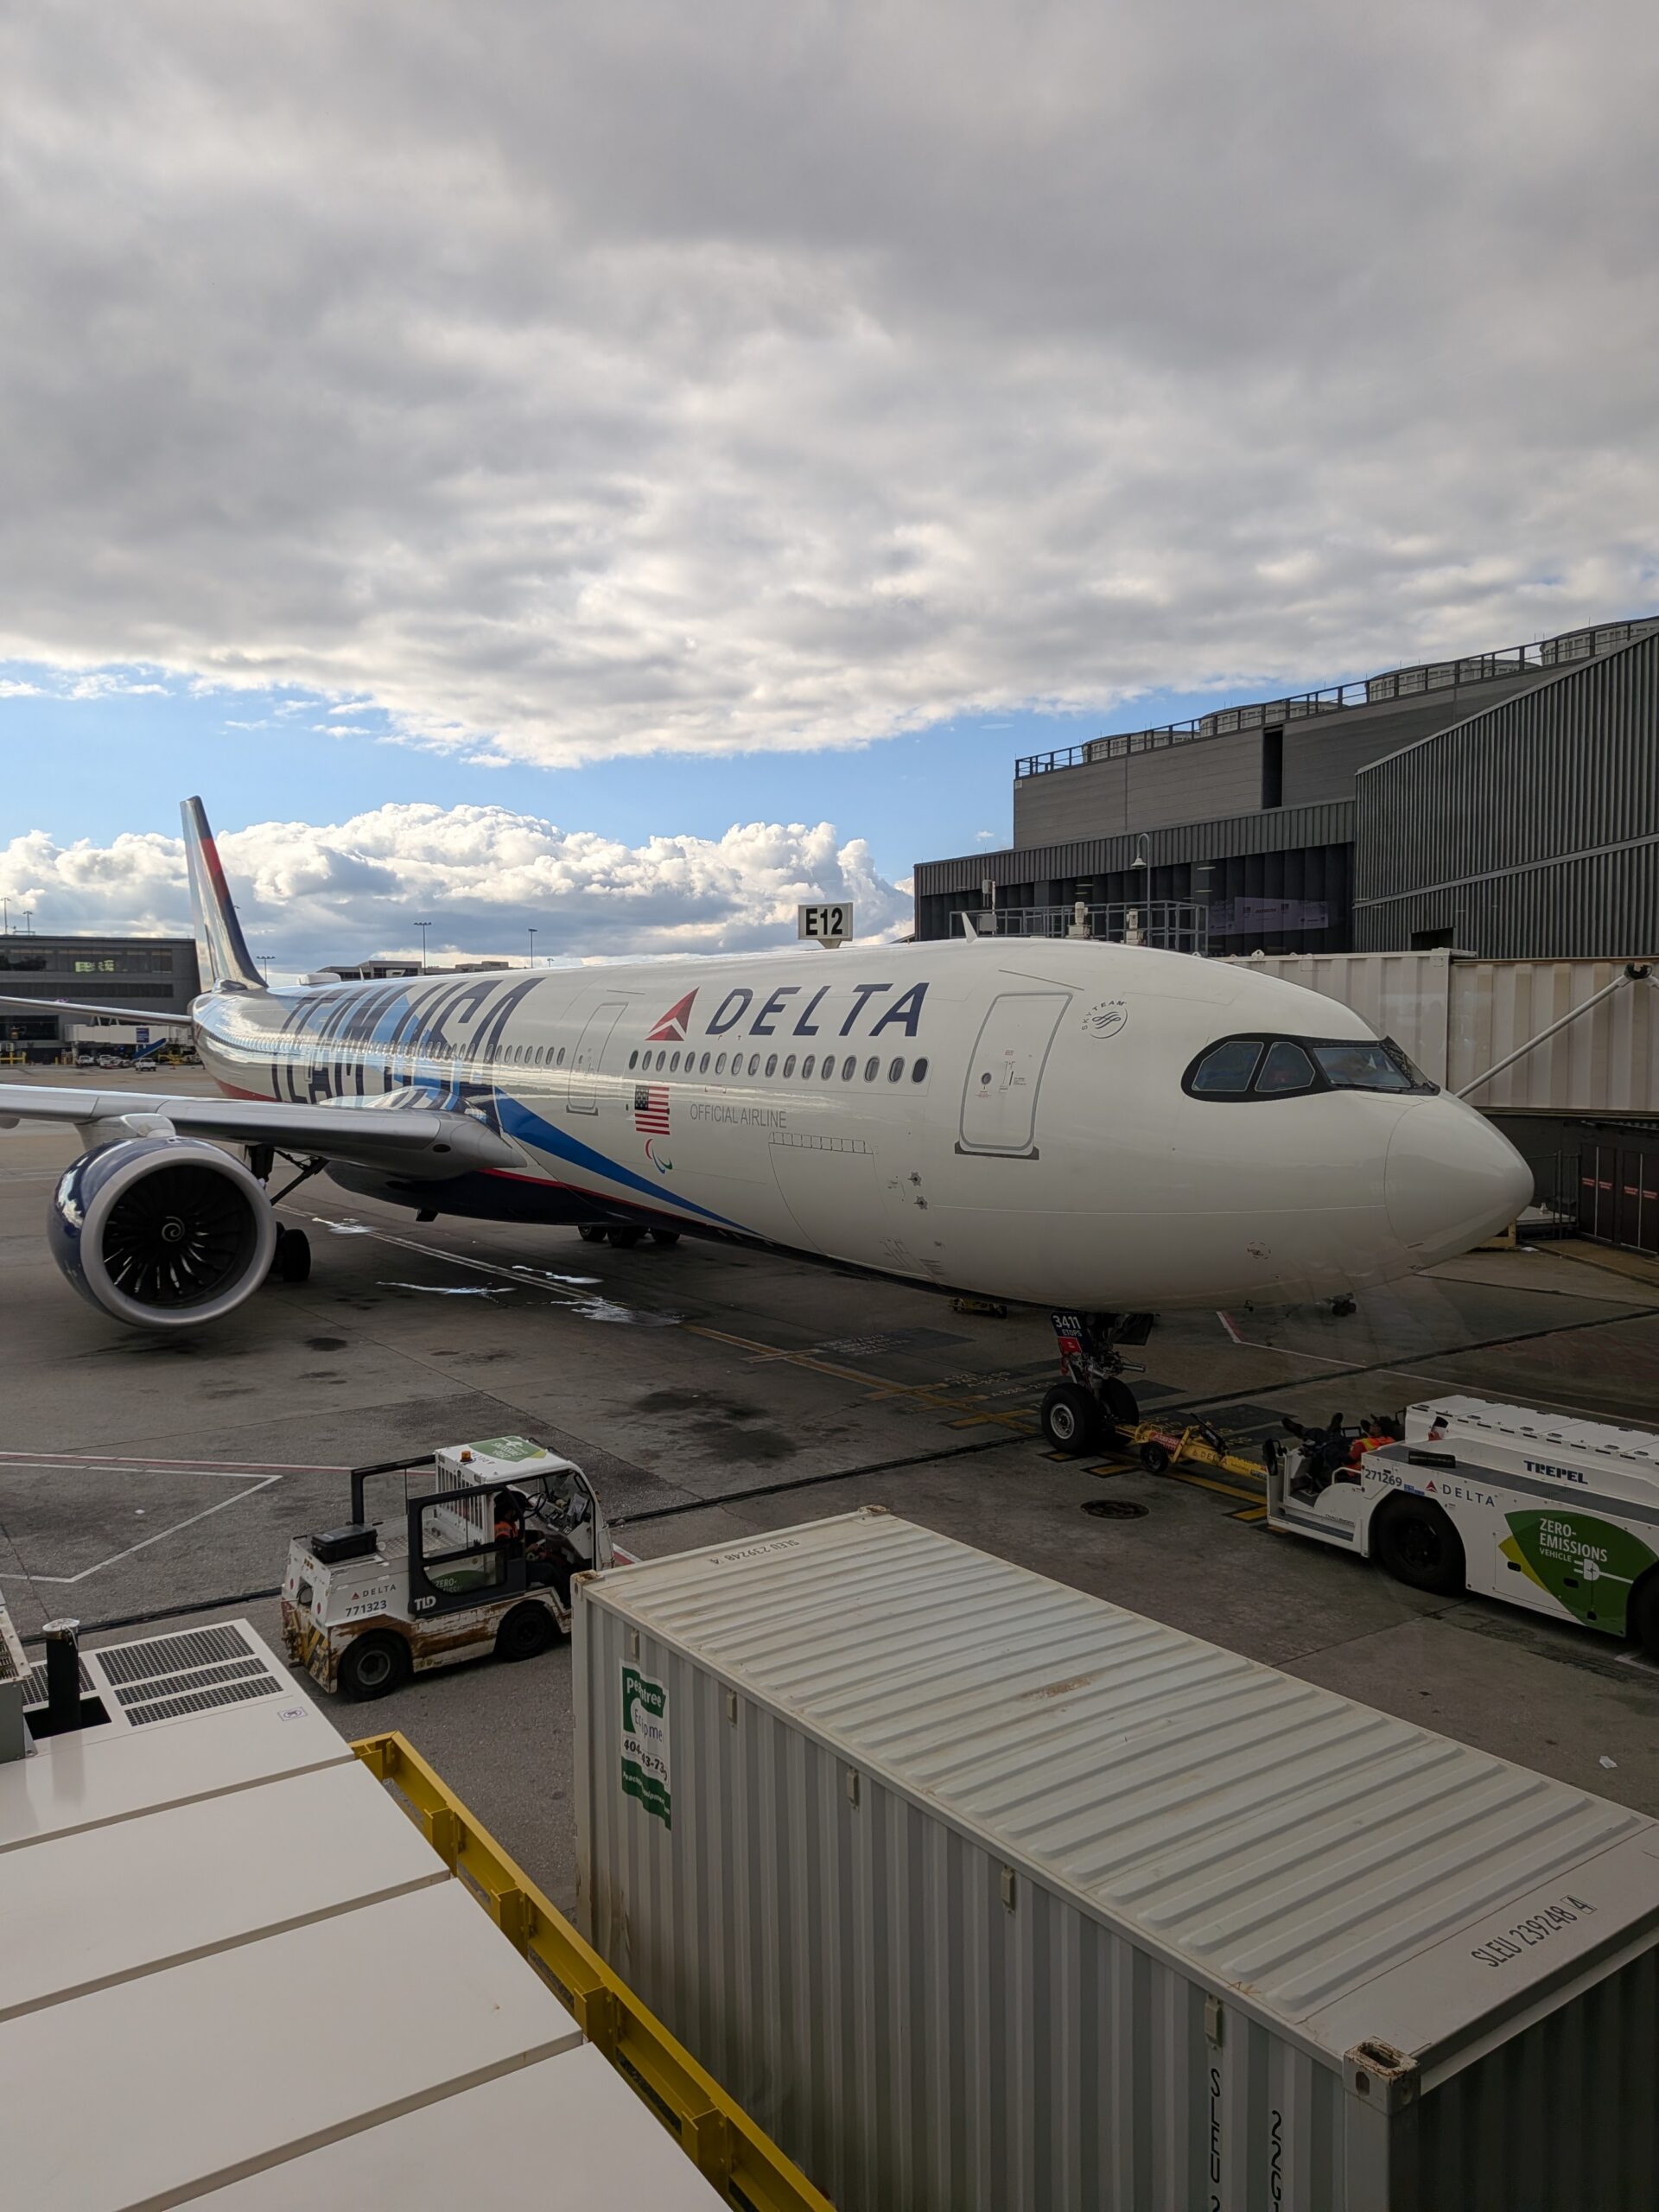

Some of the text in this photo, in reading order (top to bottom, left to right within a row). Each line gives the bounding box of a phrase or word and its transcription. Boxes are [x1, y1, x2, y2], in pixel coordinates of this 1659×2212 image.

[805, 907, 843, 935] E12
[704, 982, 930, 1037] DELTA
[1081, 1000, 1125, 1031] SKYTEAM
[690, 1103, 787, 1128] OFFICIAL AIRLINE
[1052, 1315, 1082, 1330] 3411
[1364, 1468, 1402, 1487] 271269
[1523, 1459, 1588, 1484] TREPEL
[1442, 1483, 1496, 1508] DELTA
[1540, 1517, 1577, 1537] ZERO-
[1539, 1532, 1608, 1562] EMISSIONS
[1539, 1547, 1572, 1562] VEHICLE
[362, 1584, 397, 1598] DELTA
[415, 1595, 436, 1611] TLD
[346, 1599, 387, 1618] 771323
[1471, 1936, 1522, 1968] SLEU
[1509, 1905, 1578, 1946] 239248
[1210, 2068, 1221, 2184] SLEU
